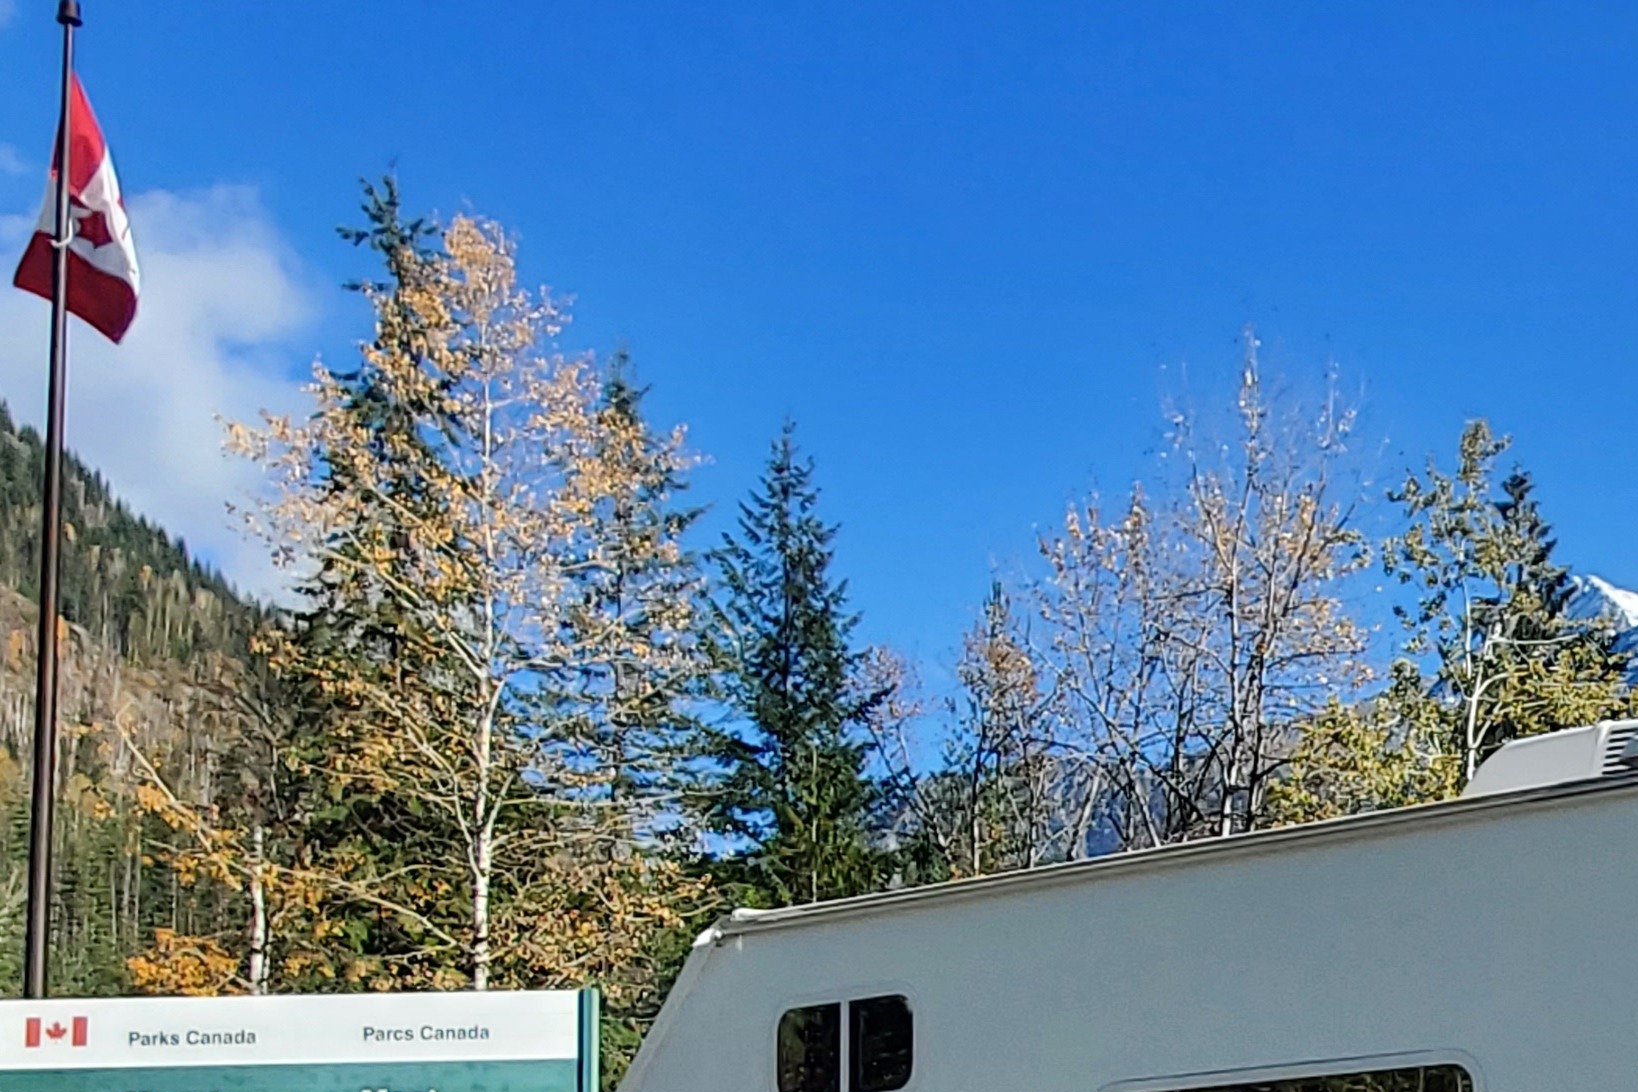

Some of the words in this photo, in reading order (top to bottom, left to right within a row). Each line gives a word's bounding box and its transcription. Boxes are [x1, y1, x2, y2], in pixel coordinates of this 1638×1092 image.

[128, 1031, 180, 1047] Parks
[186, 1029, 257, 1045] Canada
[363, 1026, 414, 1042] Parcs
[420, 1024, 490, 1040] Canada
